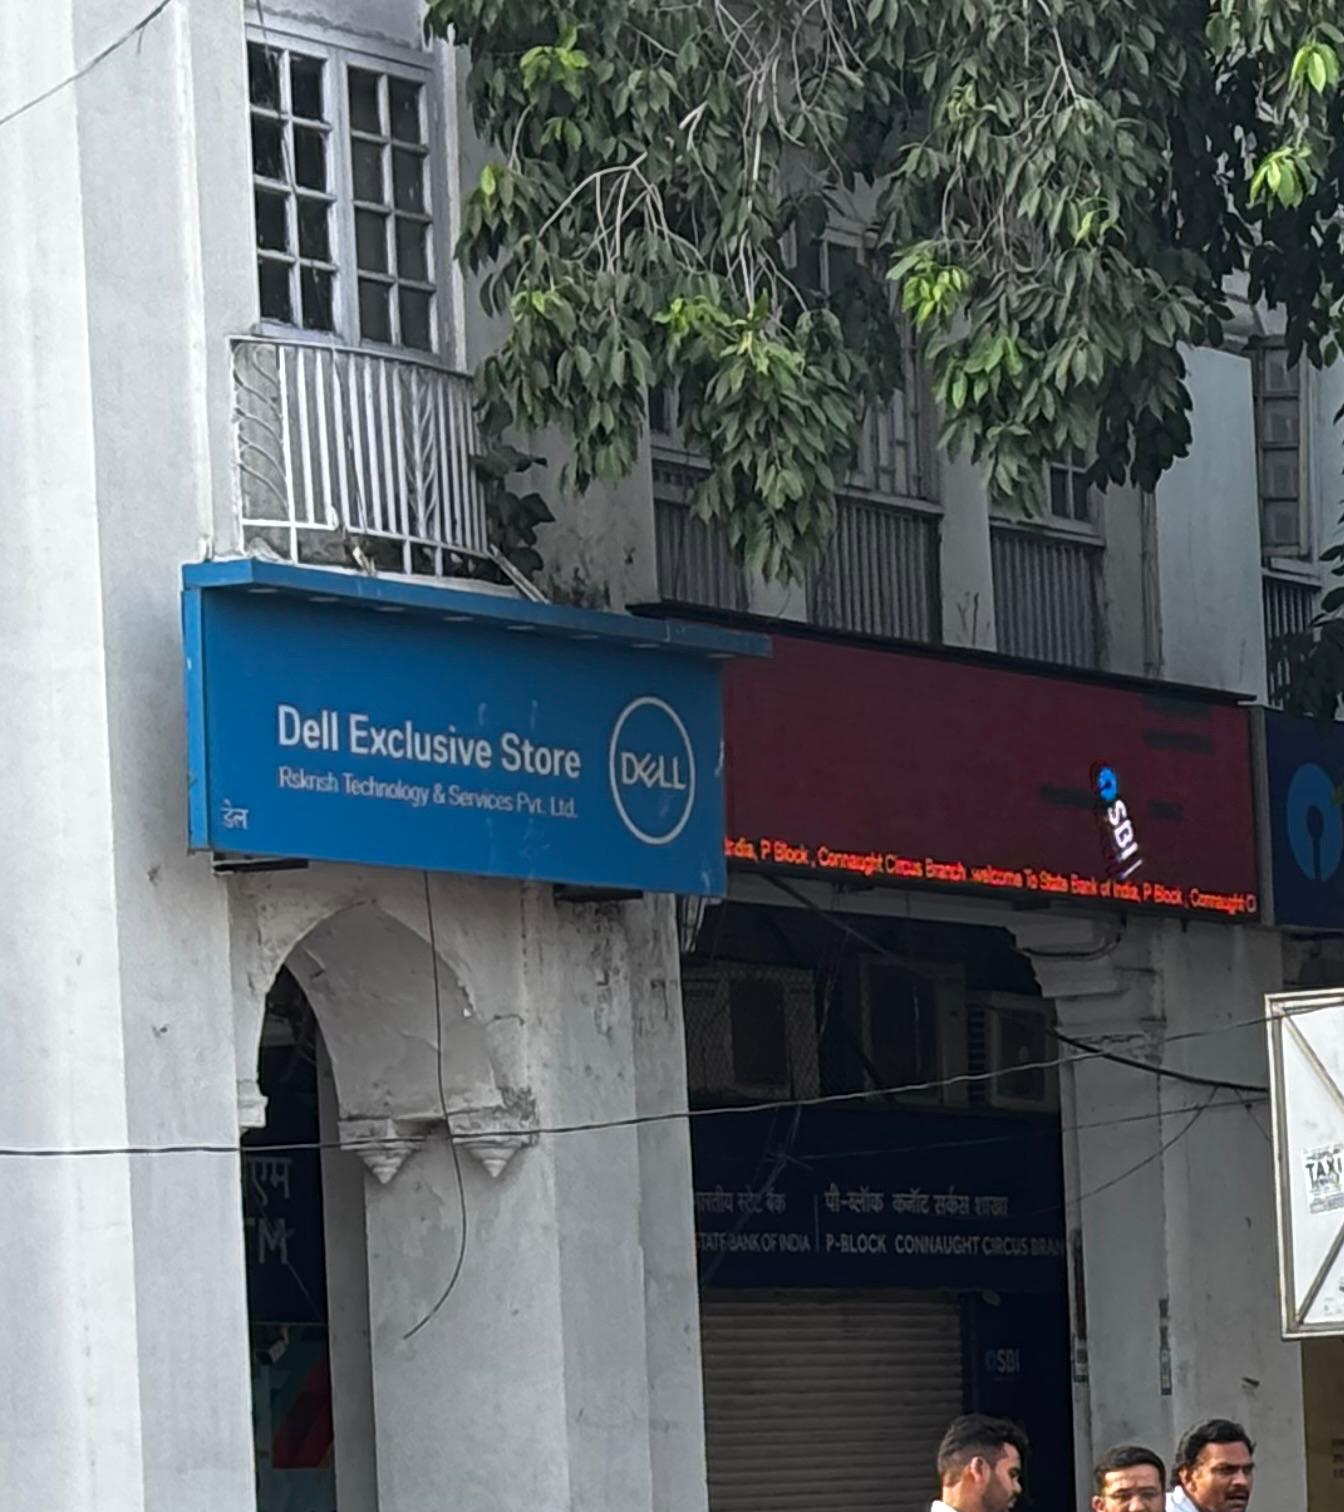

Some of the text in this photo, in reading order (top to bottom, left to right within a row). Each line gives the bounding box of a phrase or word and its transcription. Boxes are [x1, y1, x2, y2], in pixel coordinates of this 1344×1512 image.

[277, 704, 582, 779] Dell Exclusive Store
[620, 751, 687, 790] DELL
[342, 771, 430, 806] Technology
[432, 782, 446, 804] &
[448, 784, 513, 812] Services
[1107, 799, 1139, 862] SBI
[760, 838, 771, 860] P
[1039, 869, 1069, 893] State
[1142, 882, 1152, 901] P
[1305, 1157, 1343, 1188] TAXI
[778, 1232, 812, 1253] INDIA
[825, 1231, 888, 1254] P-BLOCK
[894, 1233, 980, 1255] CONNAUGHT
[981, 1235, 1030, 1256] CIRCUS
